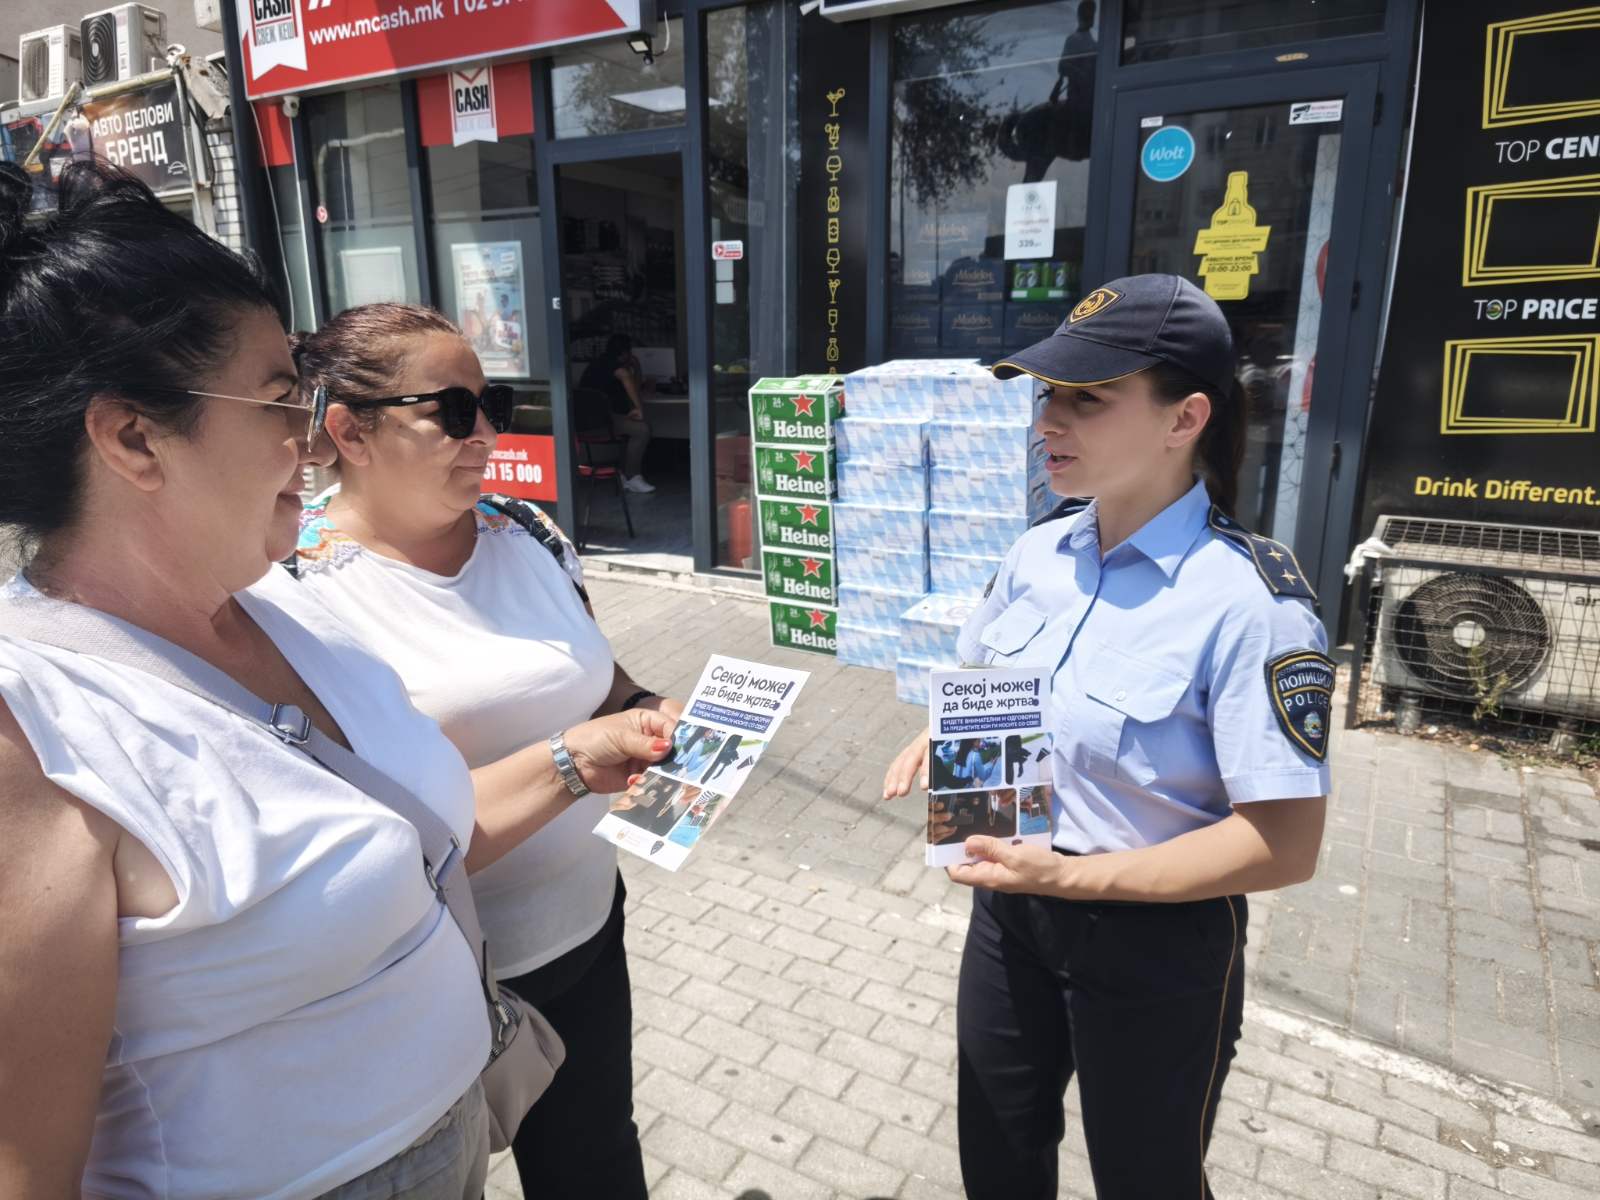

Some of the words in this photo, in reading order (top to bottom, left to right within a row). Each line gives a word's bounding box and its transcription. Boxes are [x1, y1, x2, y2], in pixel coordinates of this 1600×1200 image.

[309, 1, 444, 45] www.mcash.mk
[455, 84, 490, 113] CASH
[93, 114, 122, 137] АВТО
[124, 101, 174, 134] ДЕЛОВИ
[105, 130, 169, 169] БРЕНД
[1150, 145, 1185, 161] Wolt
[1495, 139, 1541, 164] TOP
[1474, 299, 1518, 320] TOP
[1522, 298, 1598, 320] PRICE
[499, 462, 514, 481] 15
[516, 463, 542, 483] 000
[1414, 476, 1479, 498] Drink
[1484, 479, 1600, 506] Different.
[711, 665, 751, 689] Секој
[942, 678, 986, 698] Секој
[701, 685, 716, 697] да
[717, 685, 743, 704] биде
[943, 701, 959, 713] да
[962, 697, 993, 711] биде
[1284, 692, 1329, 712] POLICE
